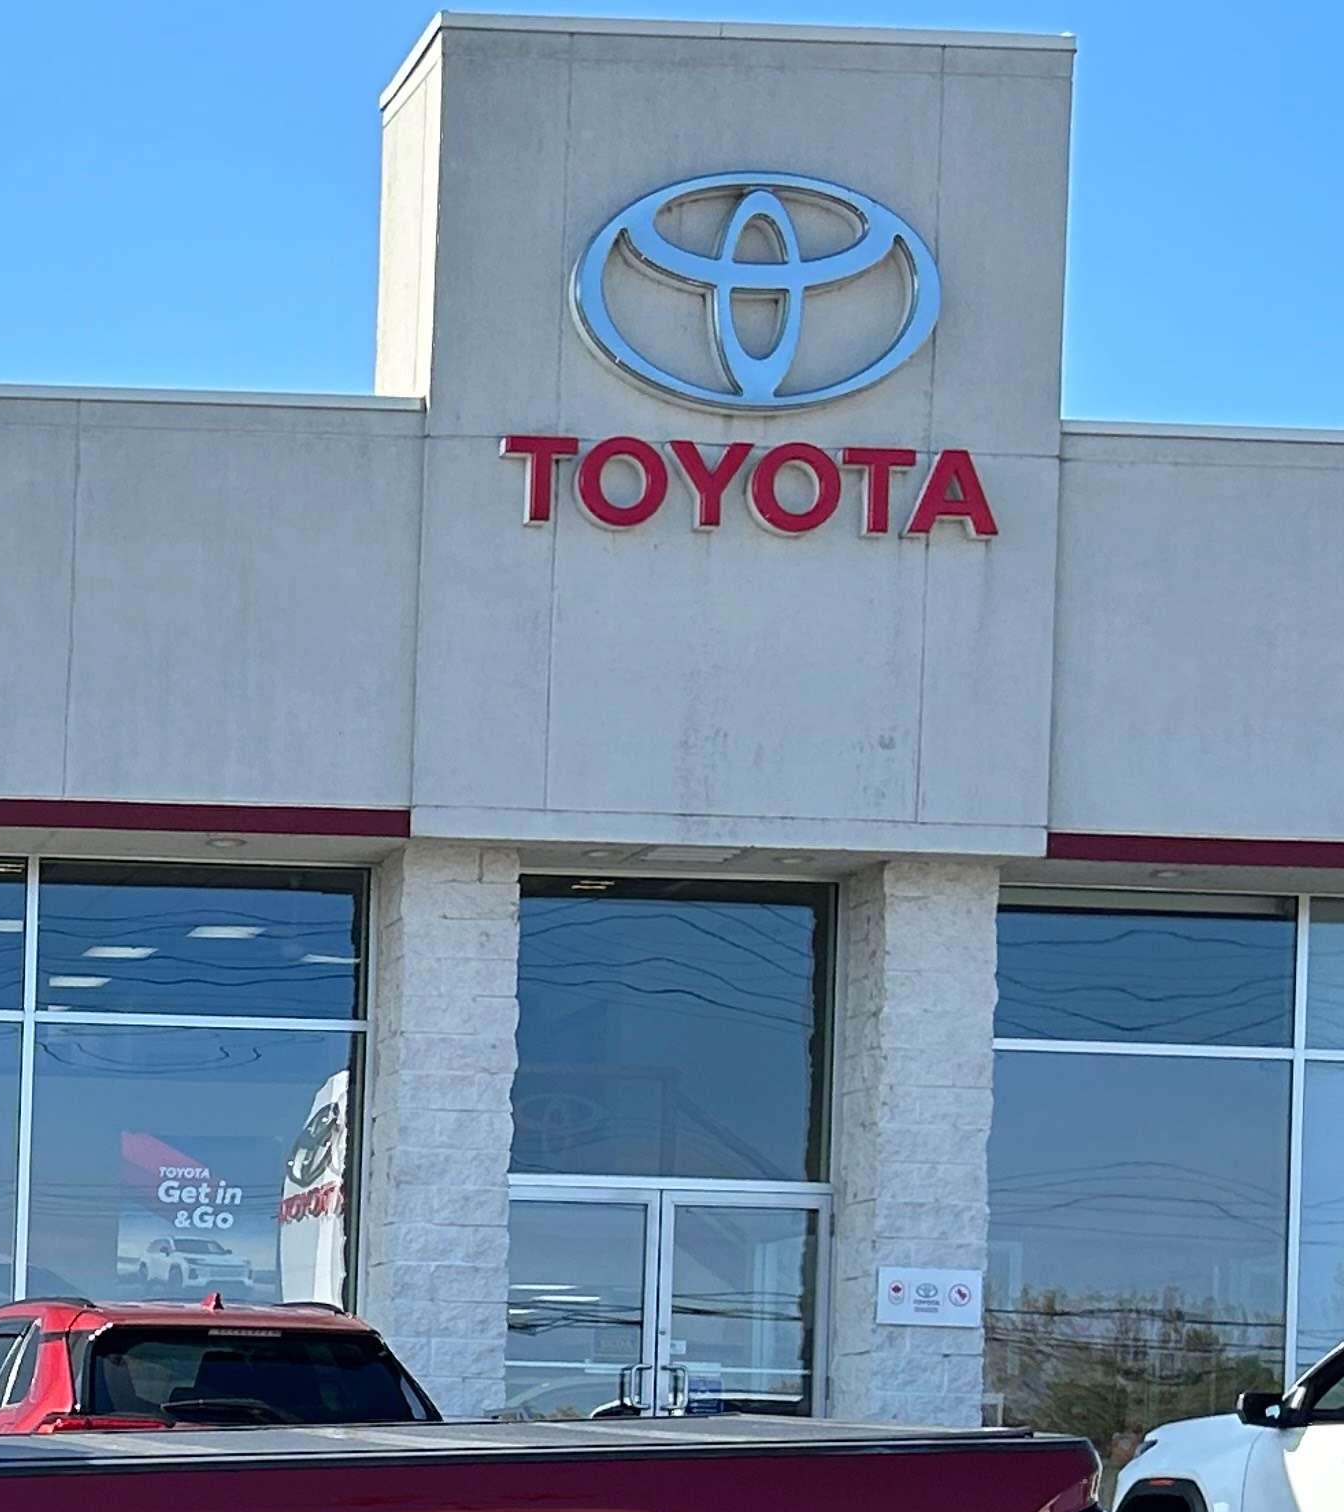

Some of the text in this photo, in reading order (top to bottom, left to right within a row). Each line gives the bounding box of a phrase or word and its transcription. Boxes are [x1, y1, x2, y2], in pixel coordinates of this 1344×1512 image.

[500, 435, 998, 539] TOYOTA
[159, 1166, 210, 1179] TOYOTA
[158, 1180, 242, 1205] Get in
